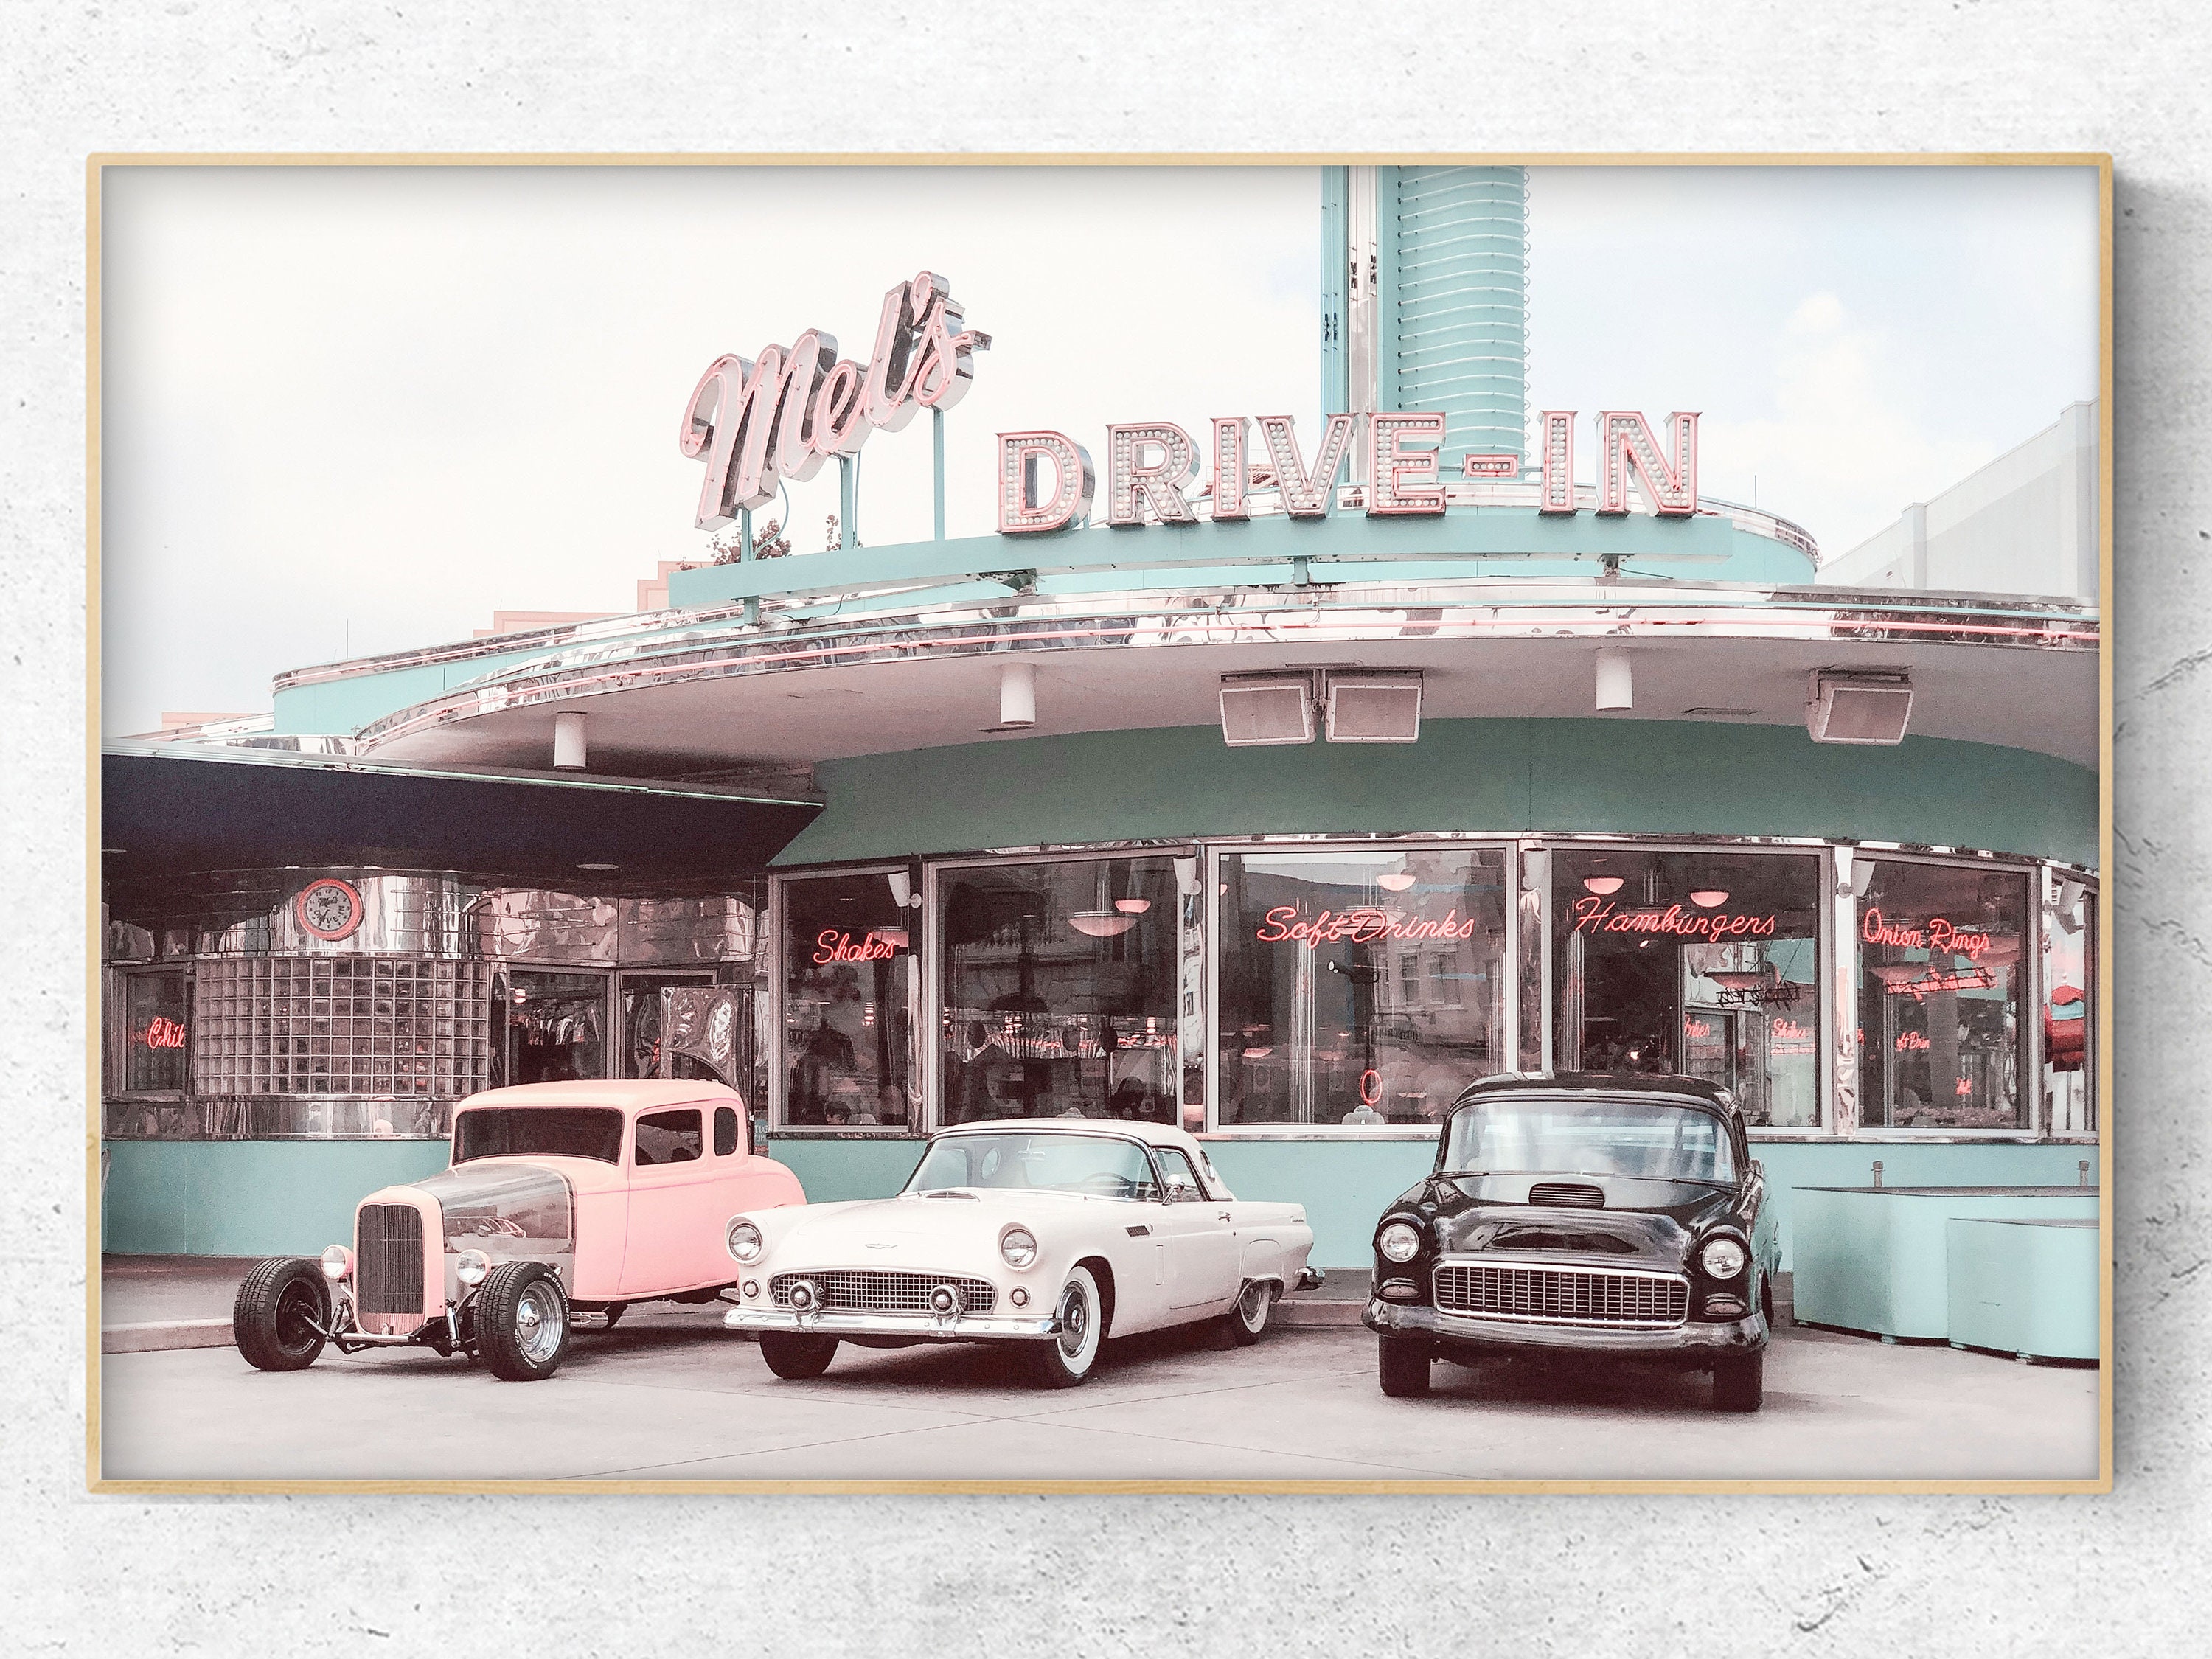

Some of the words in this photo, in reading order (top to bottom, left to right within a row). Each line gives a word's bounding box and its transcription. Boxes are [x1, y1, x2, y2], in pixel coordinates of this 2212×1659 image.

[680, 270, 992, 529] Mel's
[995, 410, 1703, 535] DRIVE-IN
[1257, 906, 1349, 949] Soft
[1350, 908, 1475, 942] Drinks
[1574, 897, 1775, 942] Hamburgers
[1864, 908, 1924, 949] Onion
[1929, 918, 1991, 960] Rings
[813, 929, 897, 964] Shakes
